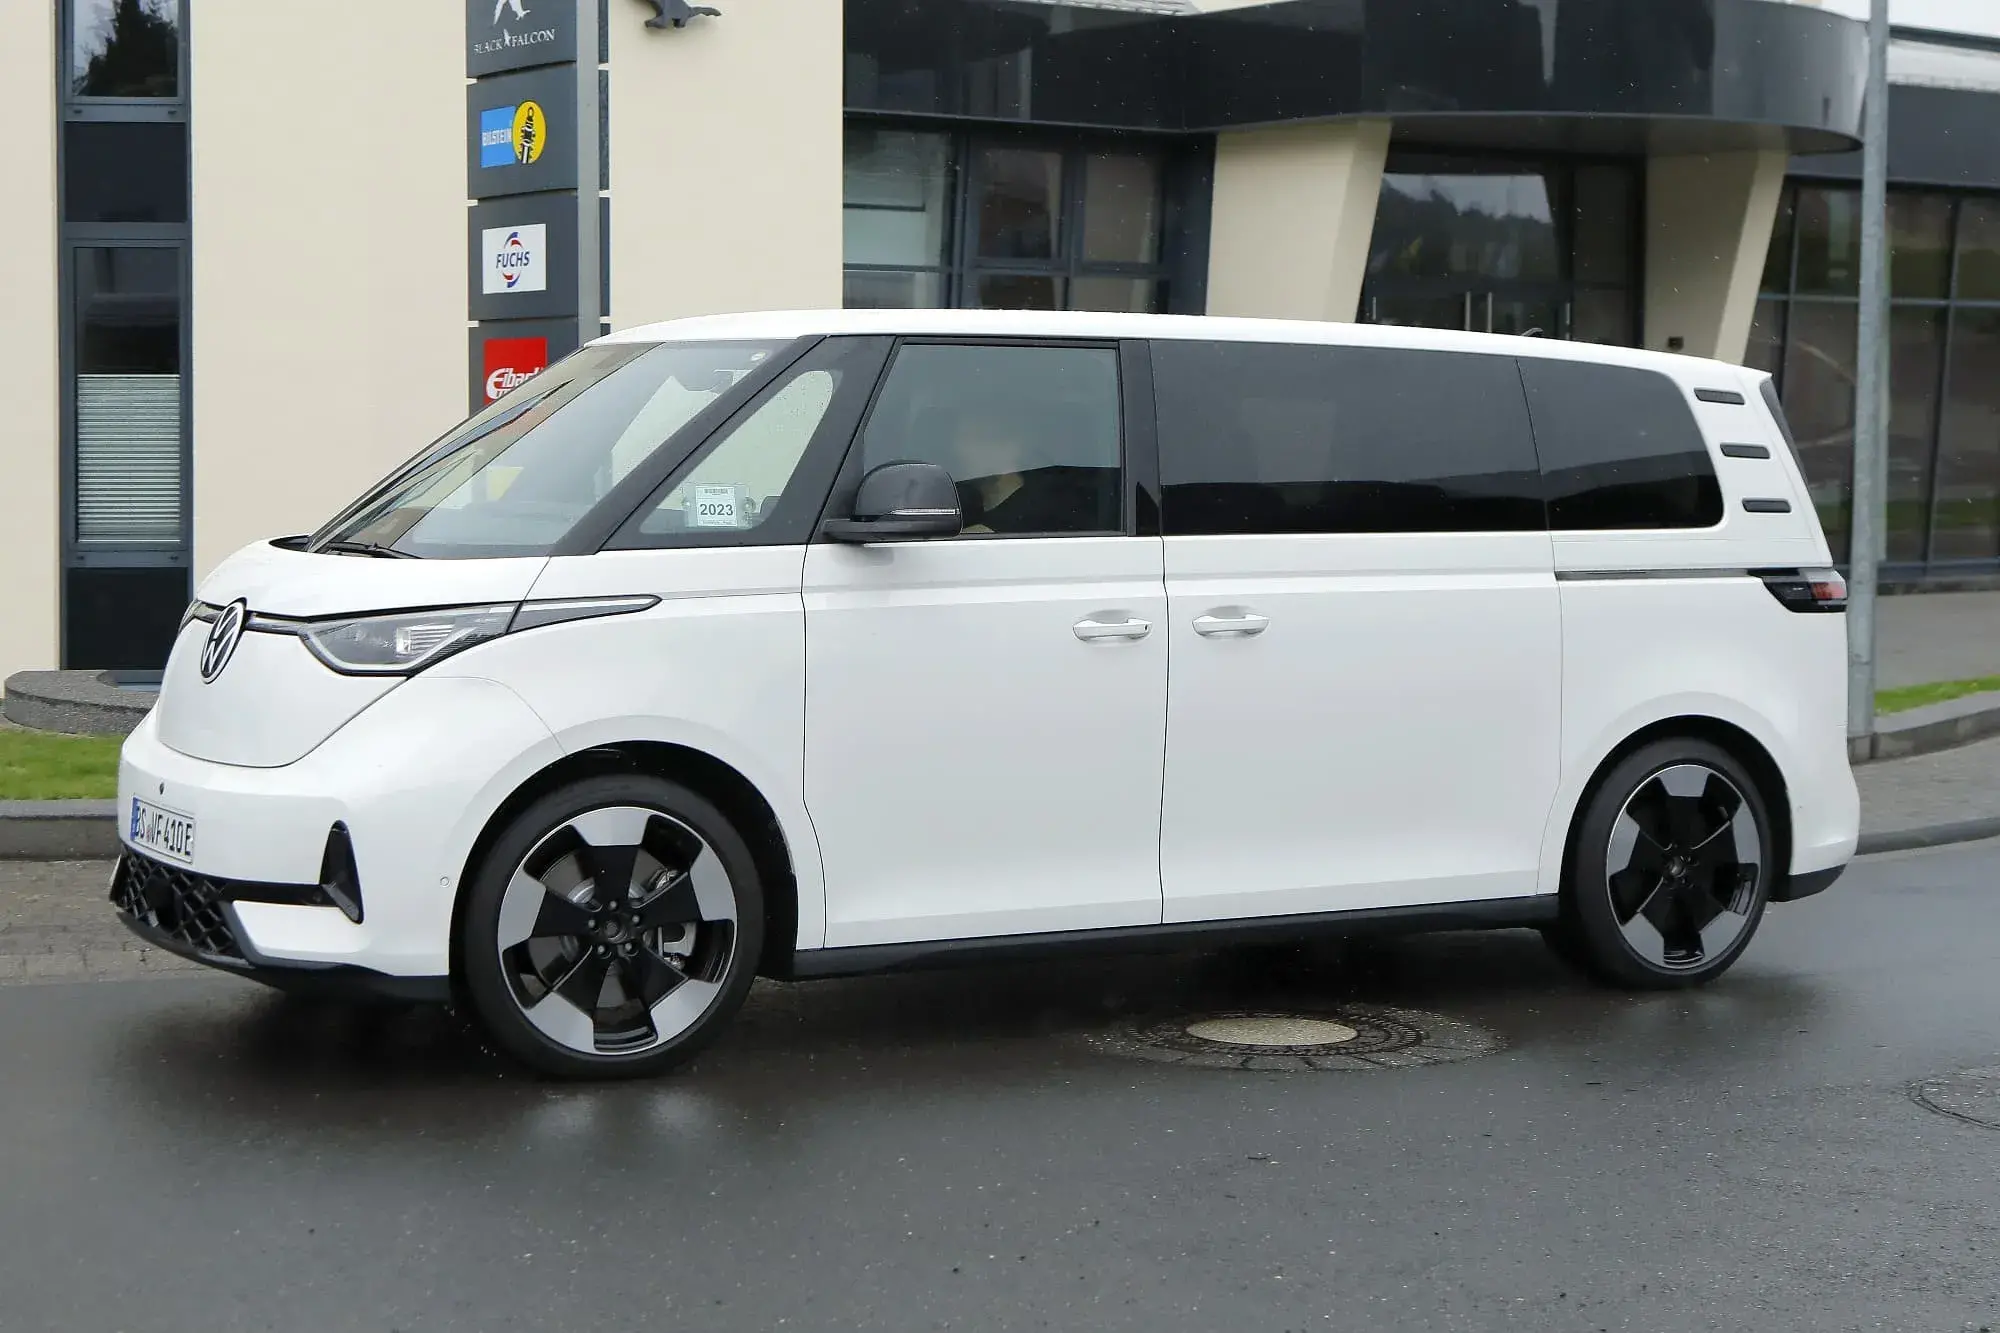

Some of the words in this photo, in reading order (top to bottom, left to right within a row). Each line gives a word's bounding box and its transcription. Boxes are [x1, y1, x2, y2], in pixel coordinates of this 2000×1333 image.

[473, 38, 503, 54] BLACK
[511, 29, 555, 47] FALCON
[482, 127, 512, 146] BILSTEIN
[496, 251, 530, 268] FUCHS
[699, 503, 734, 516] 2023
[163, 816, 193, 856] 410E
